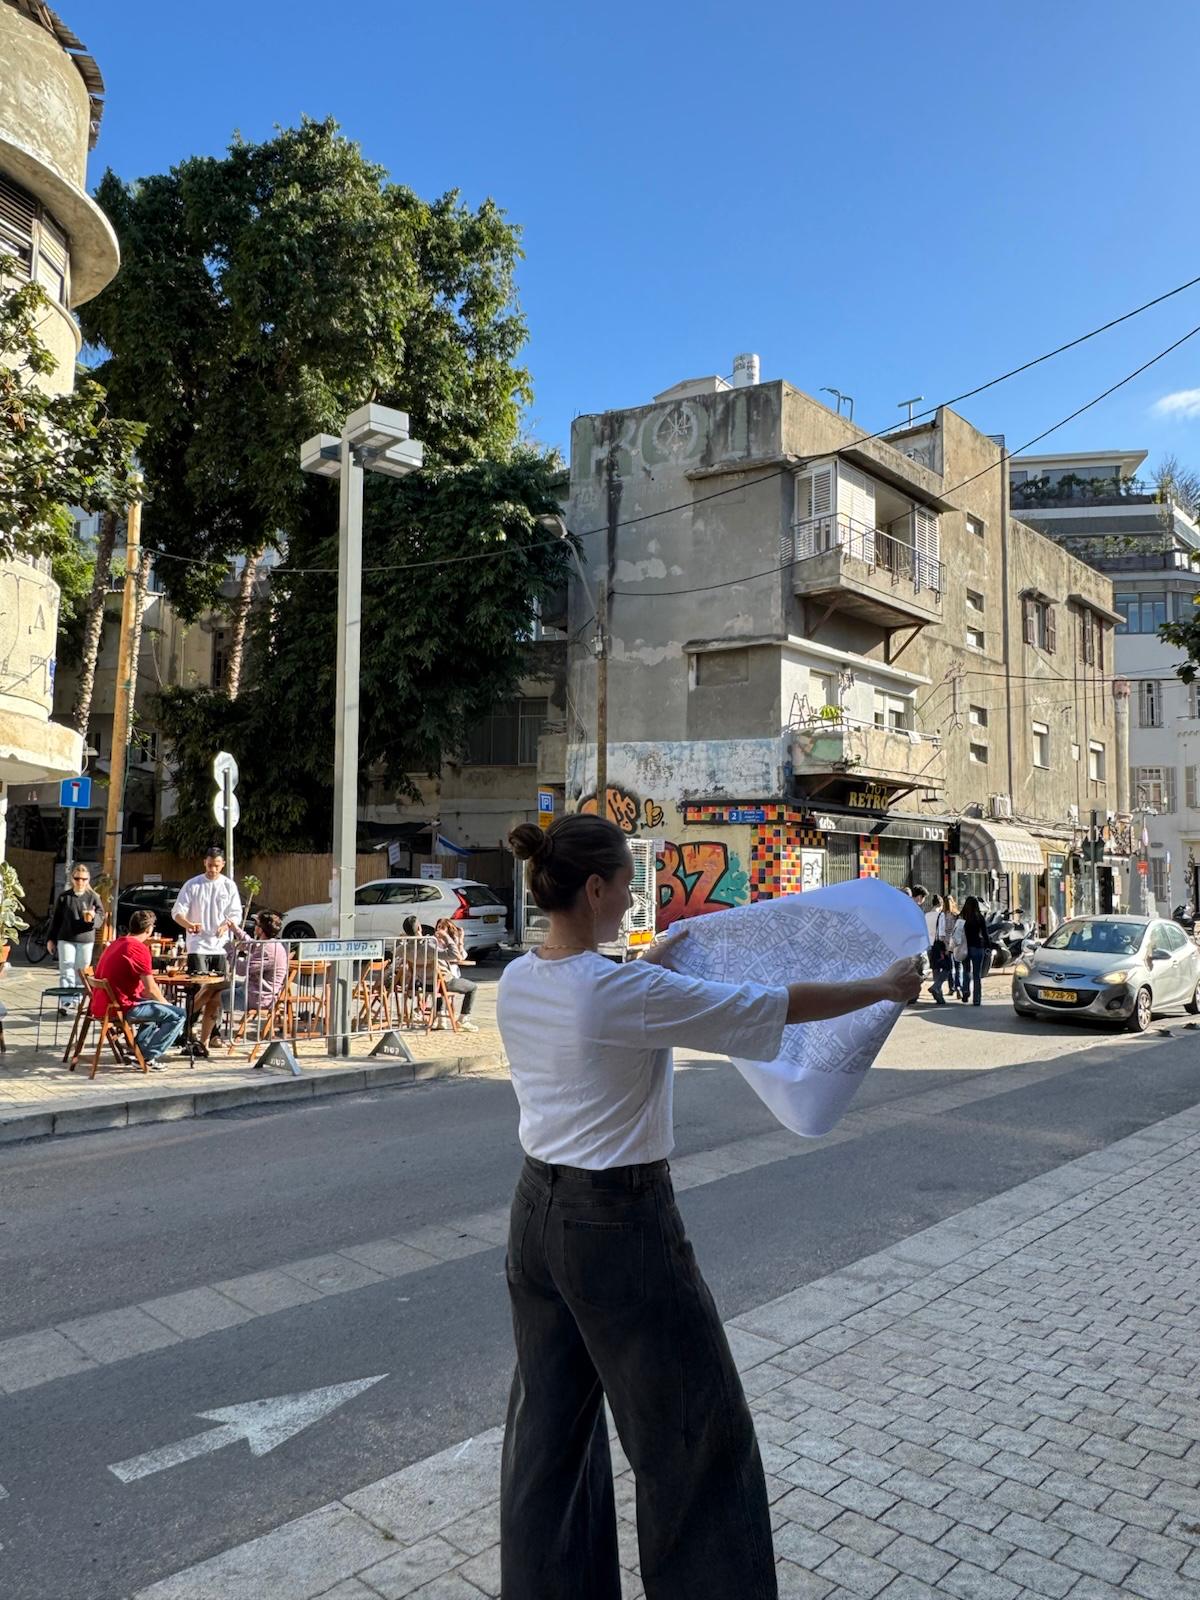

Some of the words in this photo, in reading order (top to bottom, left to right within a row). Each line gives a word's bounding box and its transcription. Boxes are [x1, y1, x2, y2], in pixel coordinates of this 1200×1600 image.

[848, 791, 889, 810] RETRO
[731, 812, 737, 820] 2
[922, 826, 945, 840] רטרו
[317, 942, 342, 952] במות
[346, 942, 368, 952] קשת
